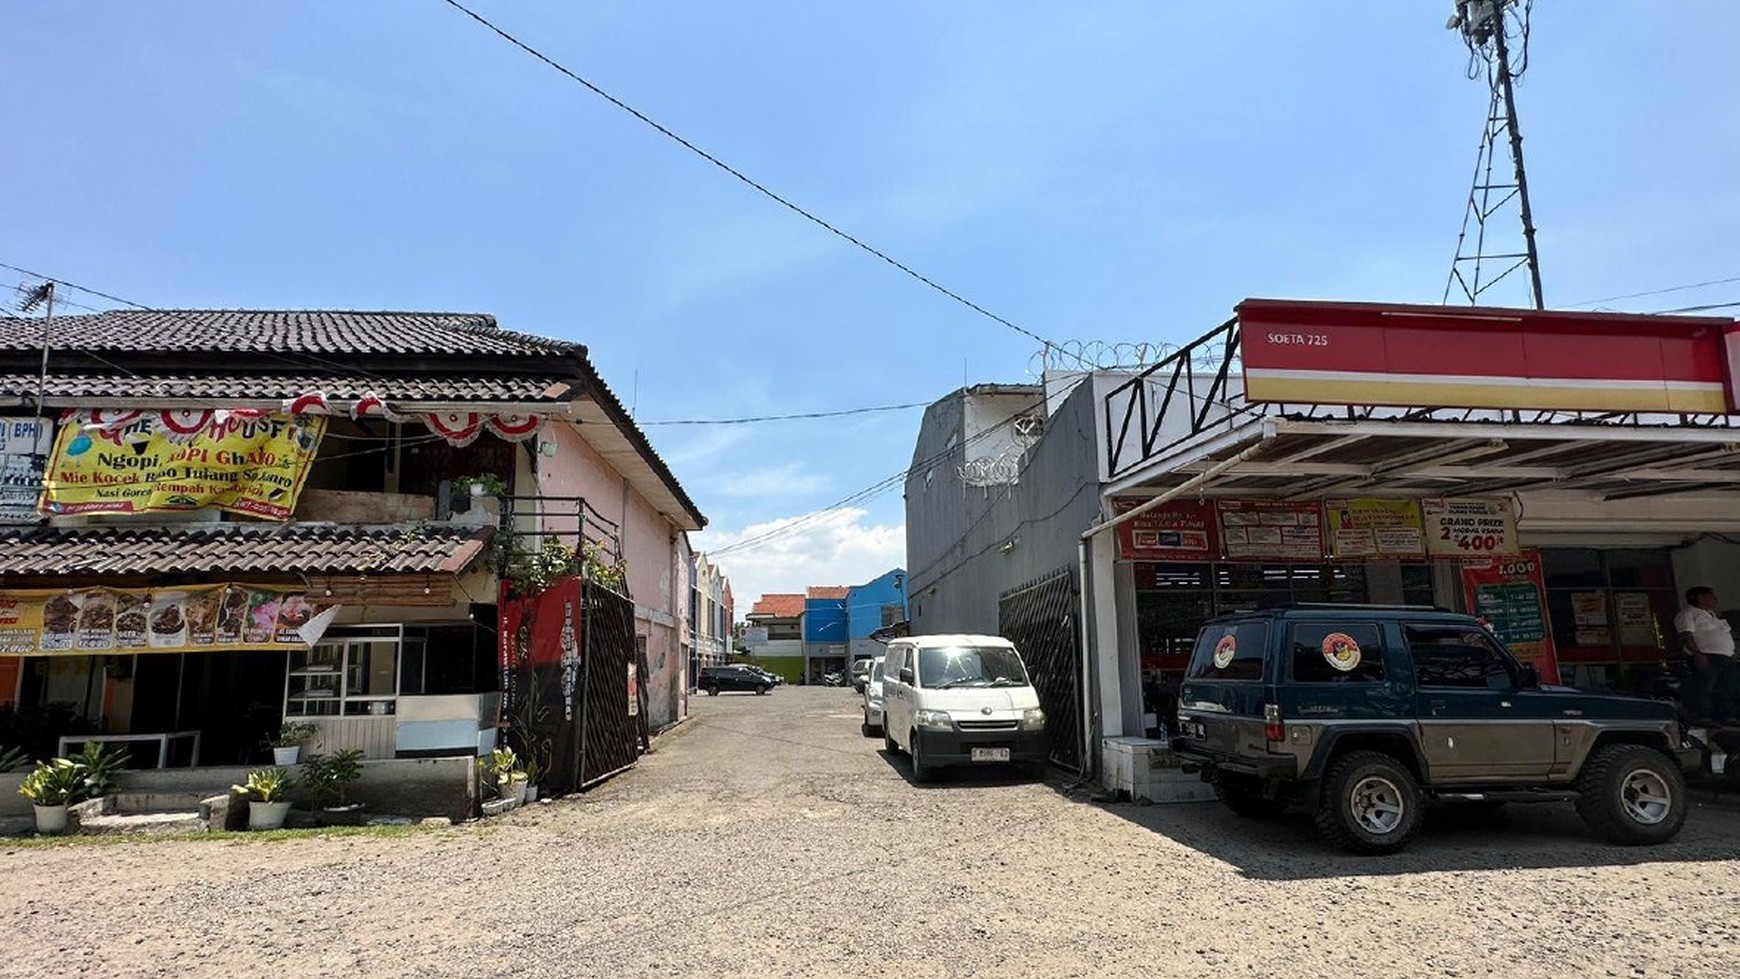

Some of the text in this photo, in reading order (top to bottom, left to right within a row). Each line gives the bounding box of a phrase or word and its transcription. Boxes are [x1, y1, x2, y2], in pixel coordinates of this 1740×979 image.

[1268, 333, 1328, 346] SOETA 725
[60, 472, 87, 485] Mie
[95, 488, 118, 498] Nasi
[1440, 517, 1504, 527] GRAND PRIZE
[1440, 526, 1451, 540] 2
[1458, 535, 1496, 550] 400
